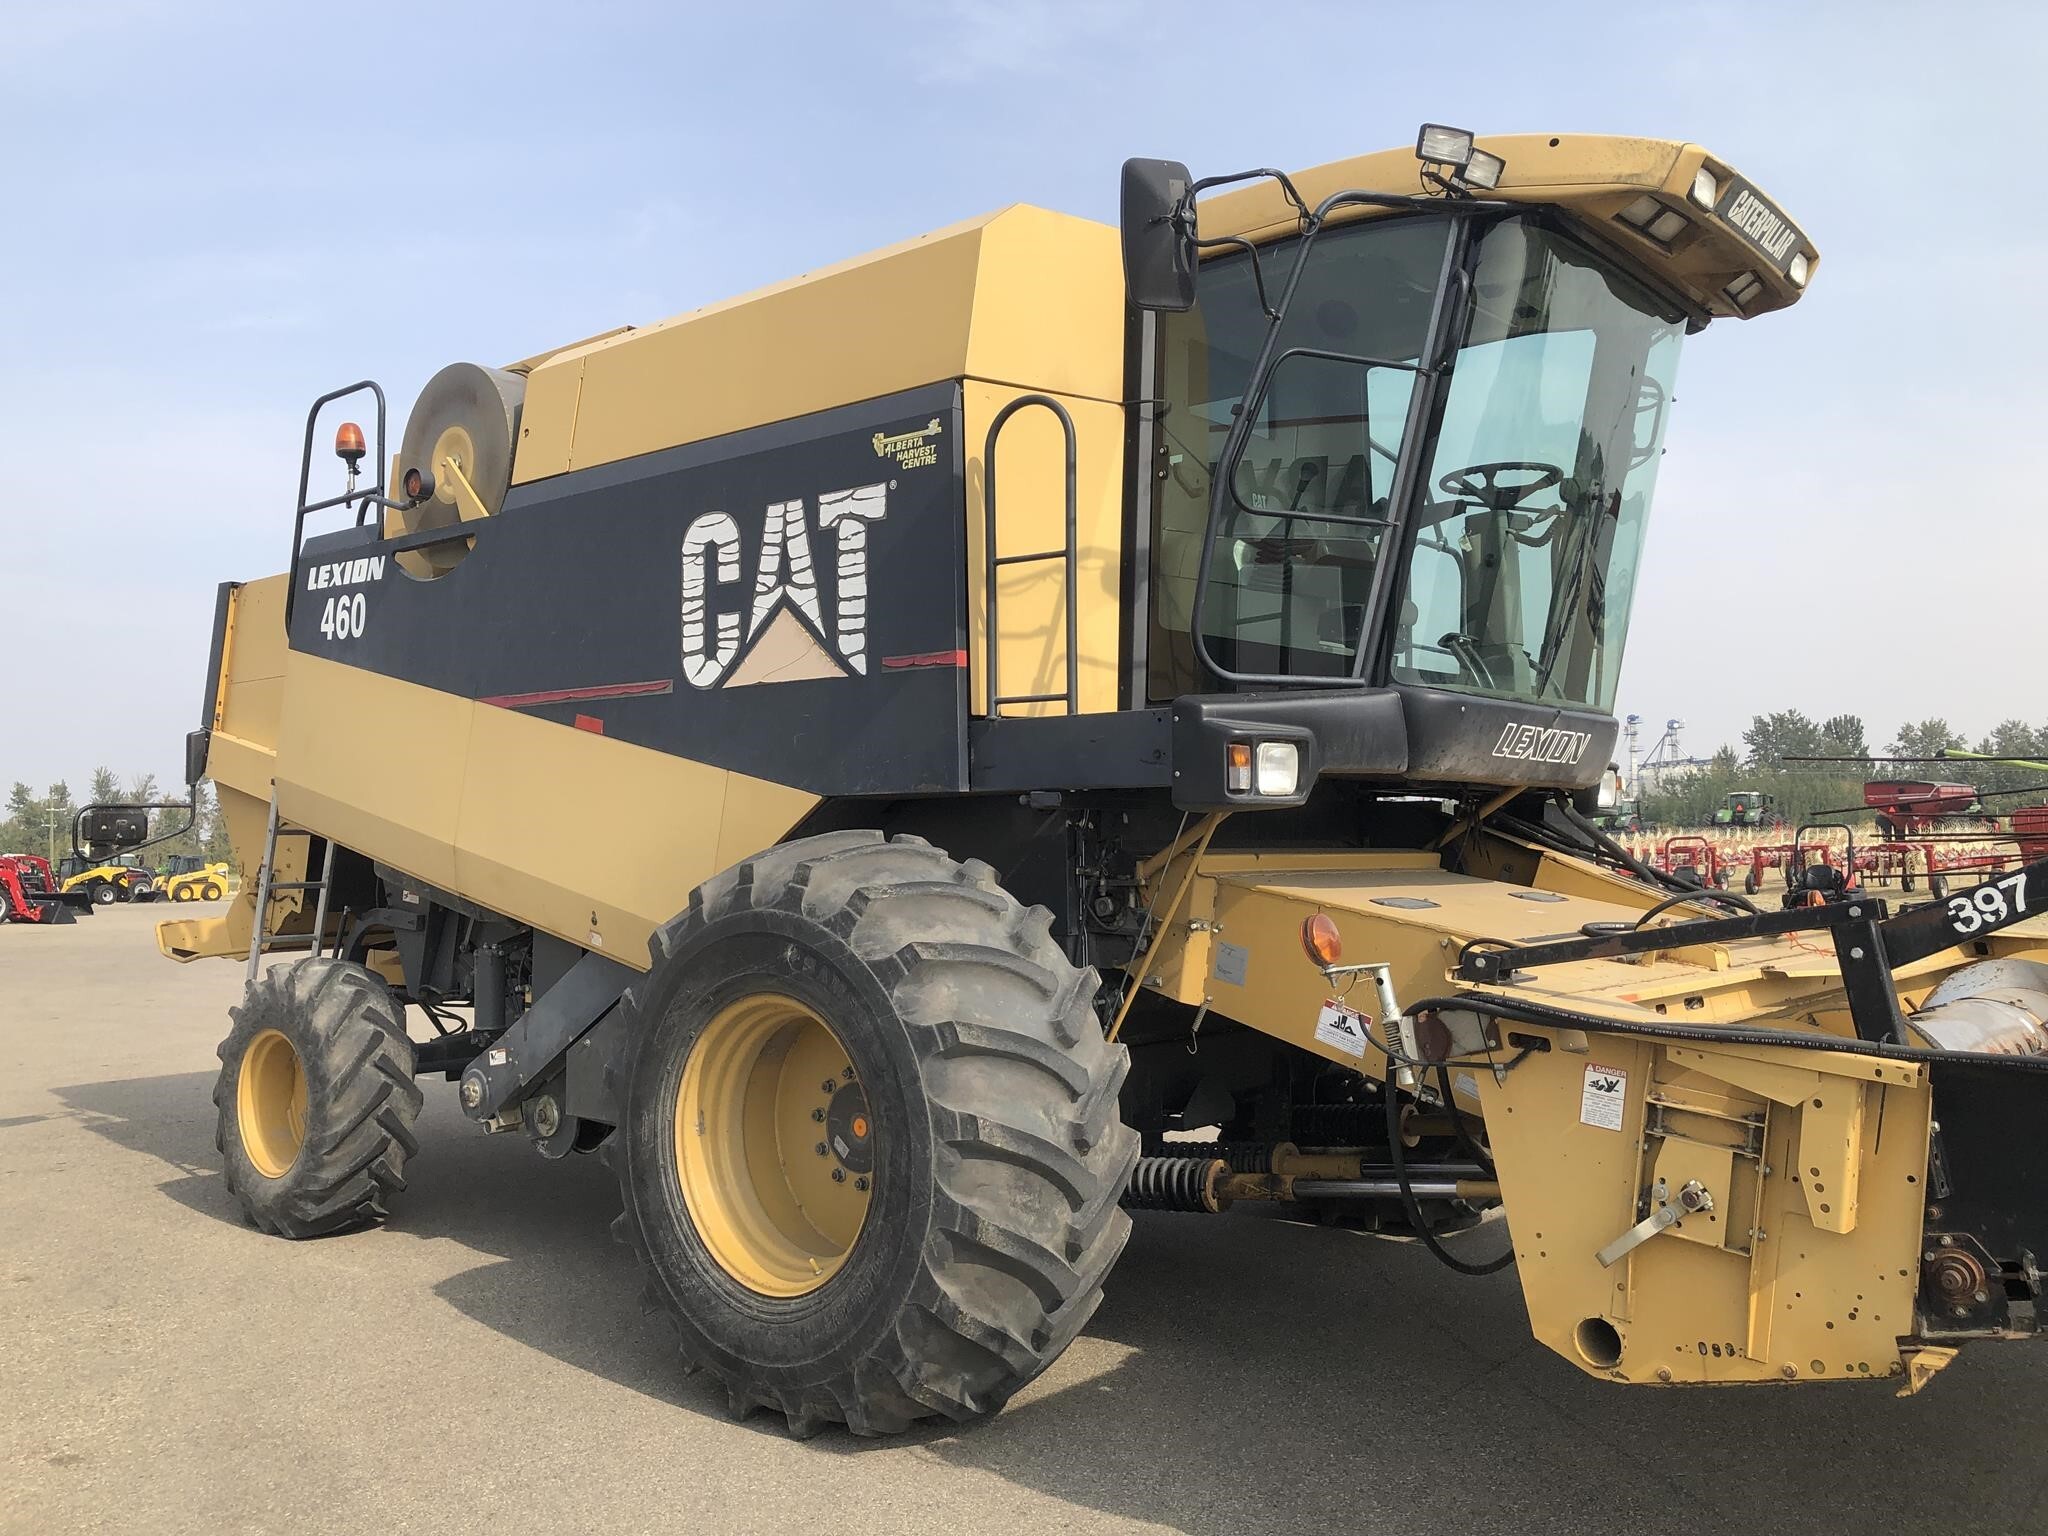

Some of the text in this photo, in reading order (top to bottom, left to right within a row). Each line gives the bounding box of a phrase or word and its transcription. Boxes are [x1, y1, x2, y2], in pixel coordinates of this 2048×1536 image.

[1728, 190, 1796, 261] CATERPILLAR
[885, 436, 923, 458] ALBERTA
[896, 445, 936, 462] HARVEST
[902, 454, 937, 470] CENTRE
[1252, 492, 1266, 509] CAT
[307, 555, 386, 591] LEXION
[681, 481, 888, 690] CAT
[320, 592, 367, 640] 460
[1492, 722, 1592, 765] LEXION
[1947, 873, 2027, 933] 397
[1595, 1065, 1627, 1077] DANGER
